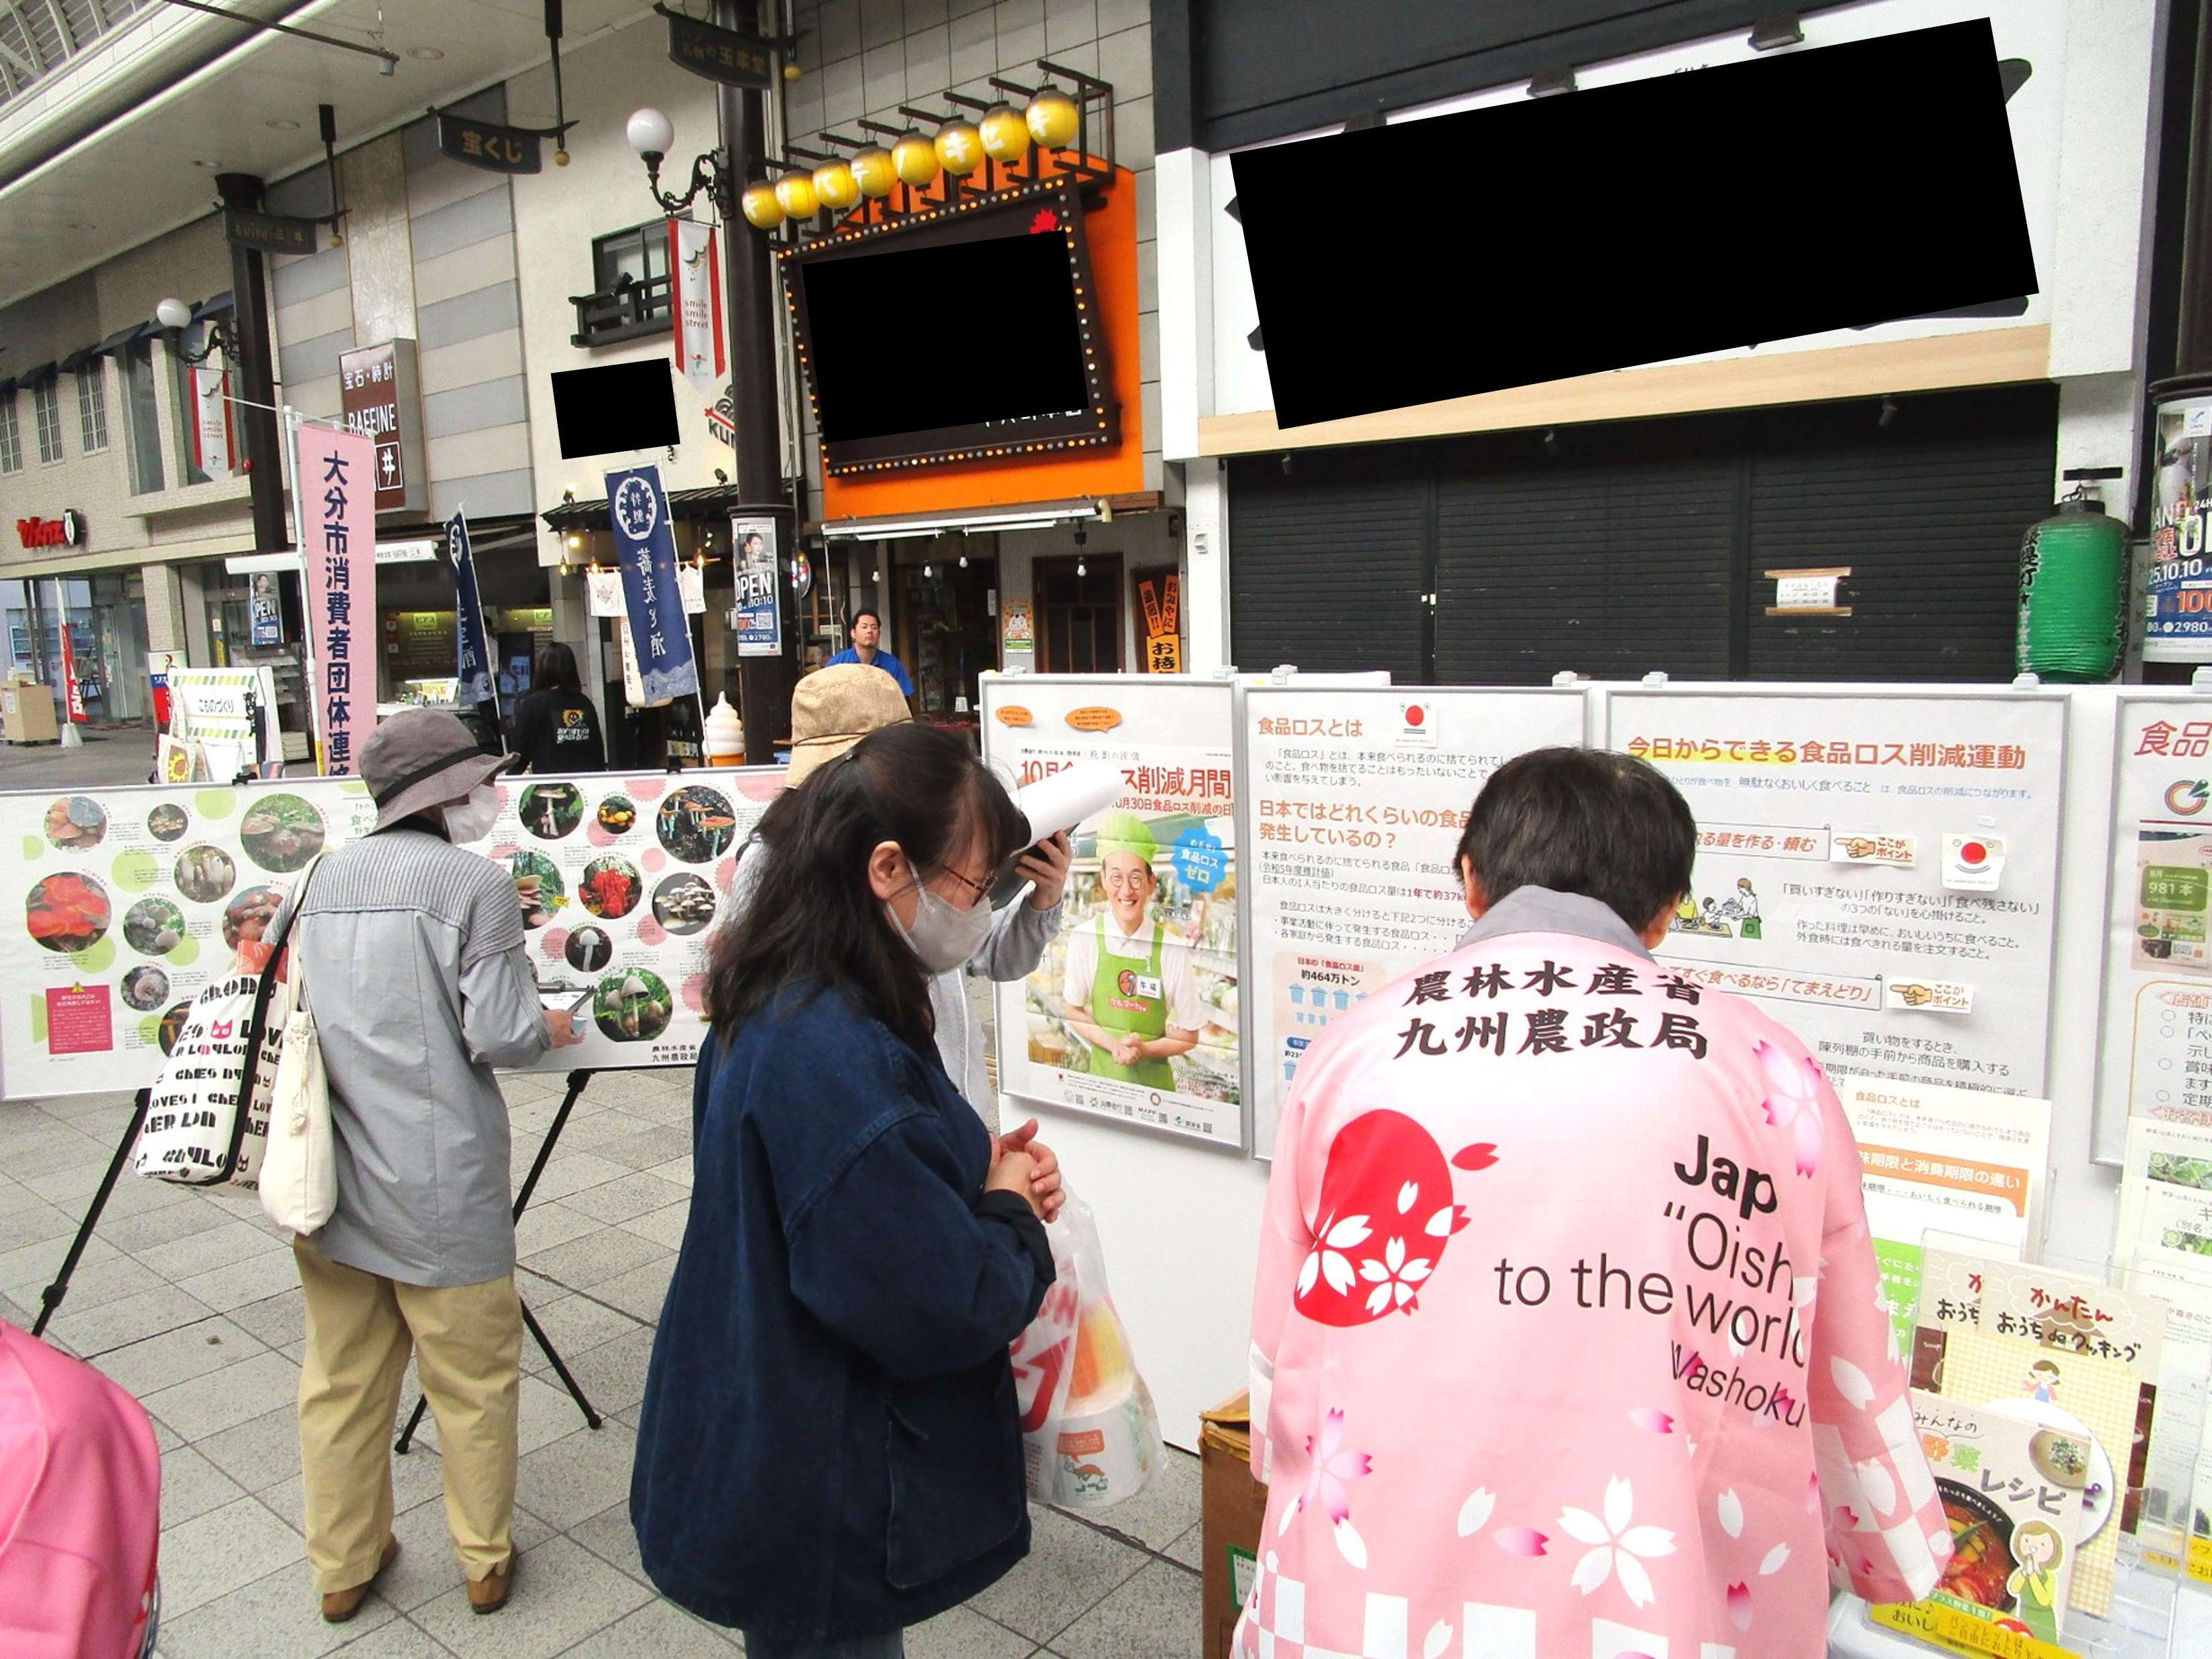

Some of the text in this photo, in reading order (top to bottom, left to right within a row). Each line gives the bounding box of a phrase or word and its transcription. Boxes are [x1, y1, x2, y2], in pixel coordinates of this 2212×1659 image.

[462, 131, 522, 164] 宝くじ
[685, 300, 707, 309] smile
[685, 309, 708, 319] smile
[686, 319, 709, 329] street
[349, 404, 397, 436] RAFFINE
[636, 547, 666, 659] 蕎麦と酒
[1152, 641, 1176, 674] お持
[1257, 717, 1363, 737] 食品ロスとは
[2134, 721, 2212, 758] 食品
[1627, 736, 2026, 770] 今日からできる食品ロス削減運動
[1739, 776, 1871, 794] 無駄なくおいしく食べること
[1111, 797, 1231, 817] 0月30日食品ロス削減の日
[1259, 800, 1471, 828] 日本ではどれくらいの食品
[1877, 848, 1913, 860] ポイント
[1878, 837, 1906, 849] ここが
[1181, 848, 1219, 869] 食品ロス
[1262, 851, 1455, 875] 本来食べられるのに捨てられる食品「食品ロ
[1185, 864, 1210, 884] ゼロ
[1300, 969, 1361, 986] 約464万トン
[1401, 960, 1706, 1007] 農林水産省
[1933, 983, 1965, 995] ここが
[1932, 995, 1970, 1007] ポイント
[1392, 1007, 1709, 1060] 九州農政局
[1818, 1040, 2010, 1077] 陳列棚の手前から商品を購入する
[1855, 1091, 1921, 1109] 食品ロスとは
[1494, 1257, 1550, 1306] to
[1571, 1252, 1674, 1316] the
[2030, 1287, 2113, 1322] かんたん
[1914, 1410, 1977, 1432] みんなの
[1980, 1469, 2067, 1516] レシピ
